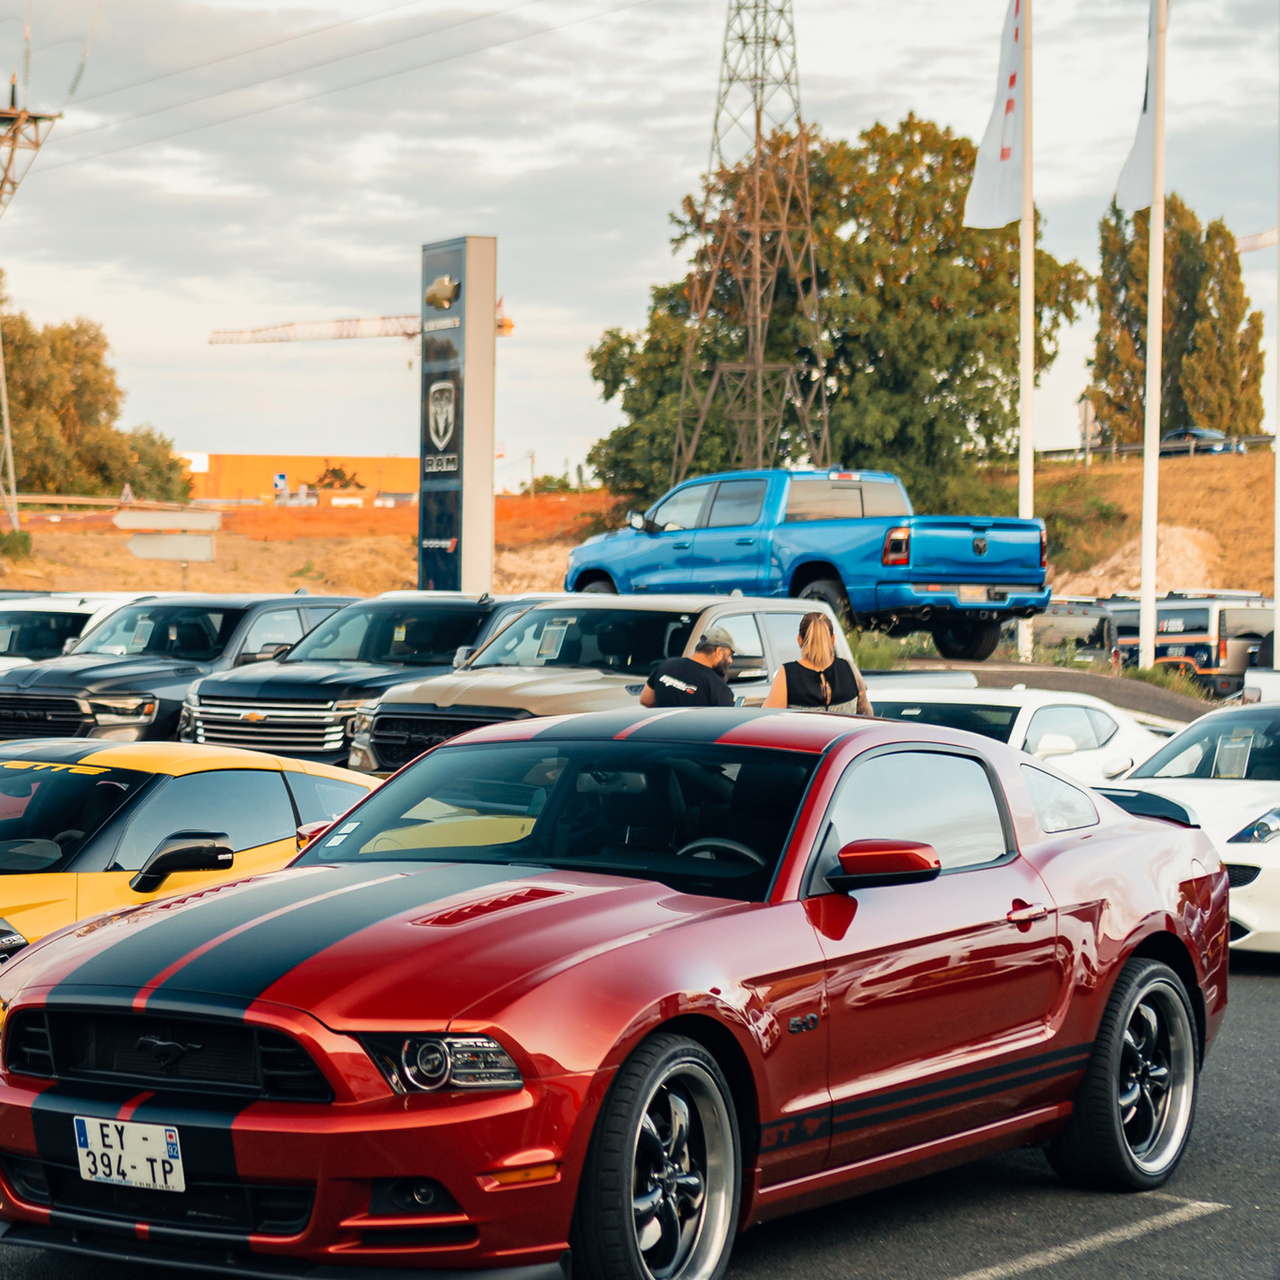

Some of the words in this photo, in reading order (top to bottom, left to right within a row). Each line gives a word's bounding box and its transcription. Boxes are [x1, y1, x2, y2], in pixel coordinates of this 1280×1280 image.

[425, 455, 458, 472] RAM
[1, 710, 44, 720] RAM
[761, 1122, 796, 1148] GT
[167, 1145, 179, 1157] 92
